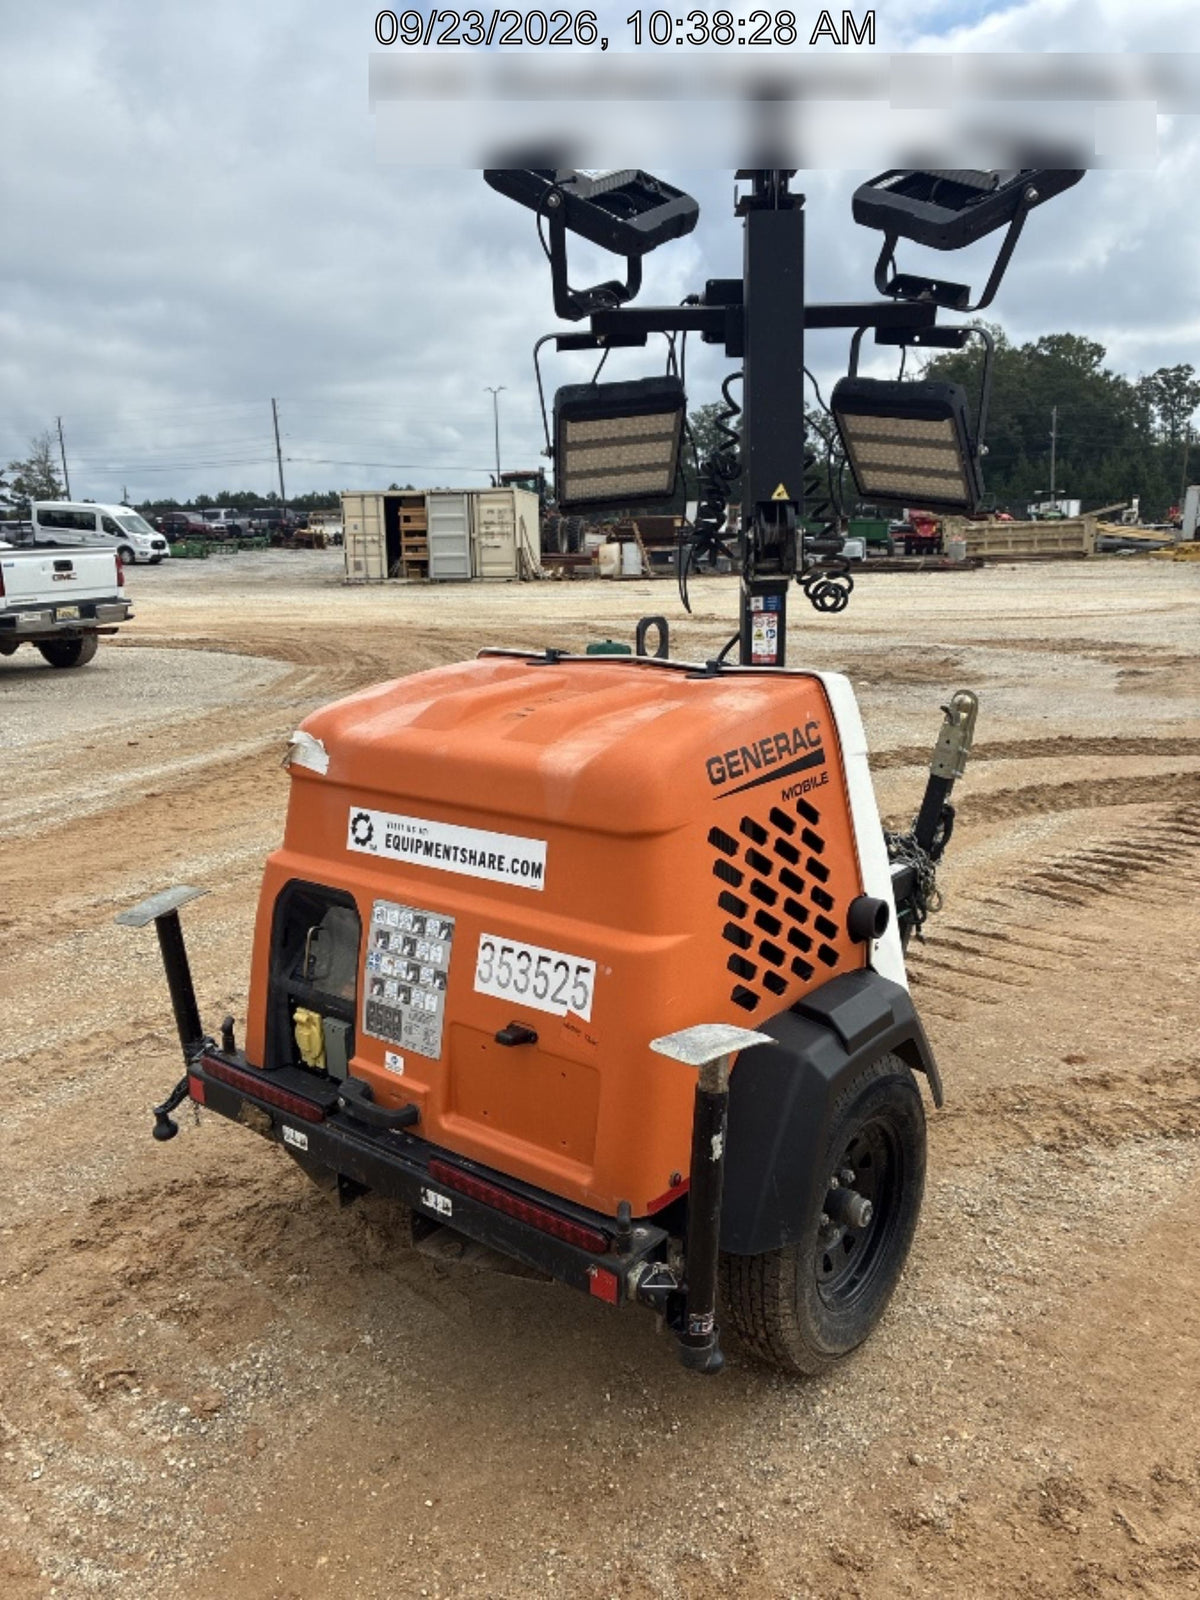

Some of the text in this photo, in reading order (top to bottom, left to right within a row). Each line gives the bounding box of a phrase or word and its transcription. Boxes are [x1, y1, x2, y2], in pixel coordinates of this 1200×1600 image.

[52, 572, 78, 581] GMC
[706, 721, 822, 786] GENERAC
[781, 771, 829, 801] MOBILE
[385, 833, 545, 880] EQUIPMENTSHARE.COM
[477, 941, 591, 1010] 353525
